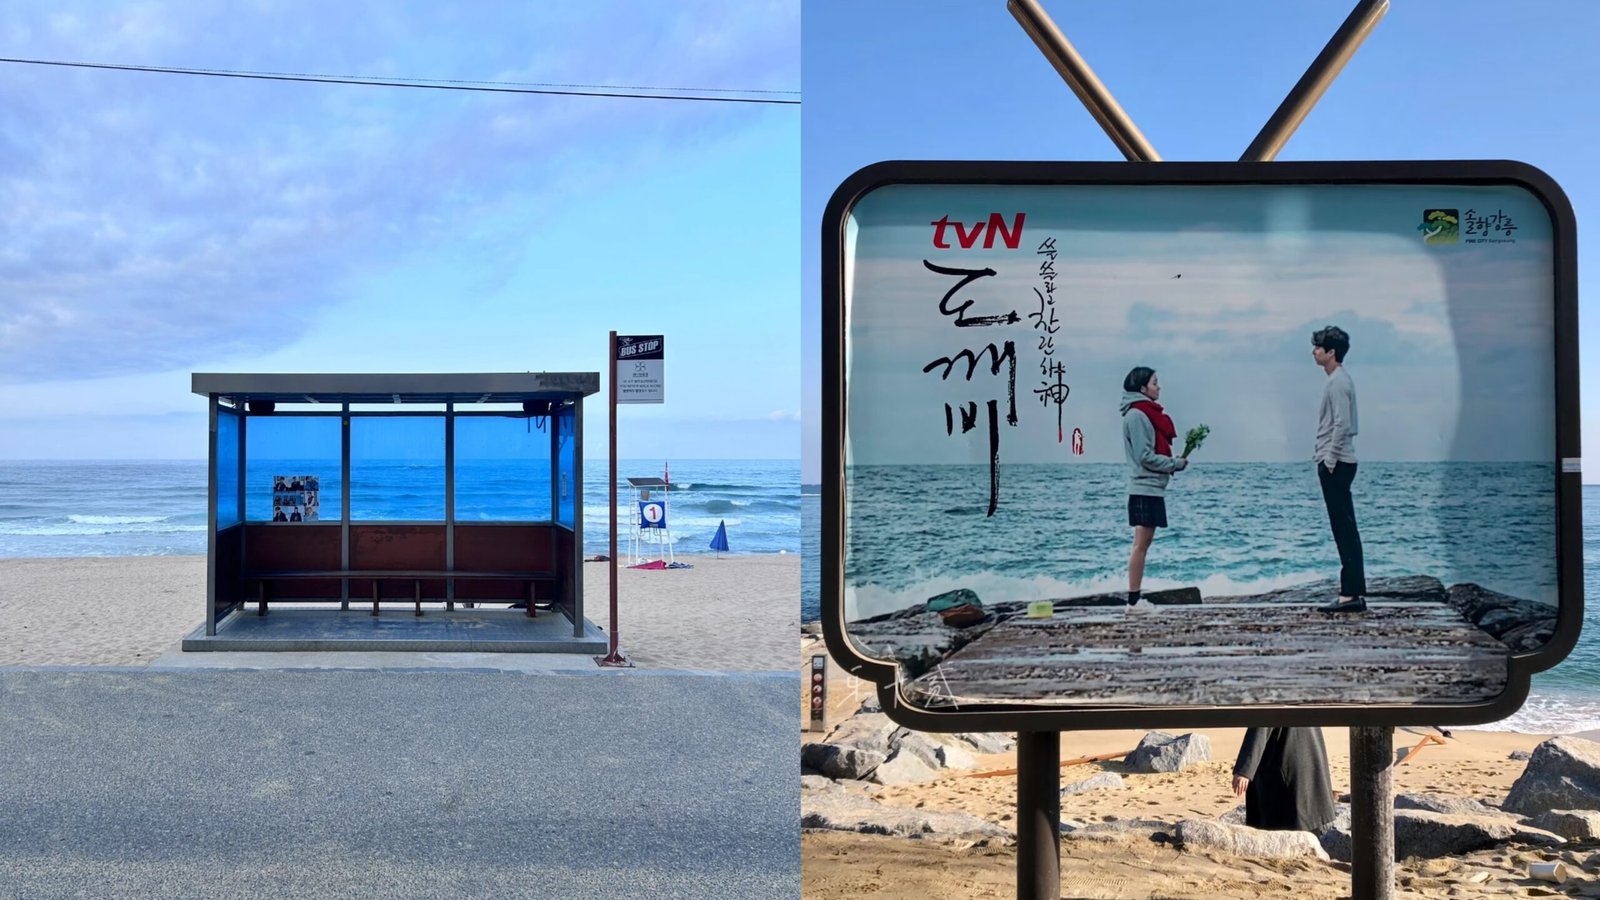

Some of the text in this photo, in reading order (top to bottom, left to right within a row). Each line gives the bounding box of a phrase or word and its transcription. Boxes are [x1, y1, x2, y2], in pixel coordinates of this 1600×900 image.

[931, 212, 1025, 249] tvN
[1465, 209, 1518, 236] 솔향강릉
[621, 341, 659, 357] BUS STOP
[923, 259, 1021, 518] 도깨비
[649, 507, 656, 519] 1
